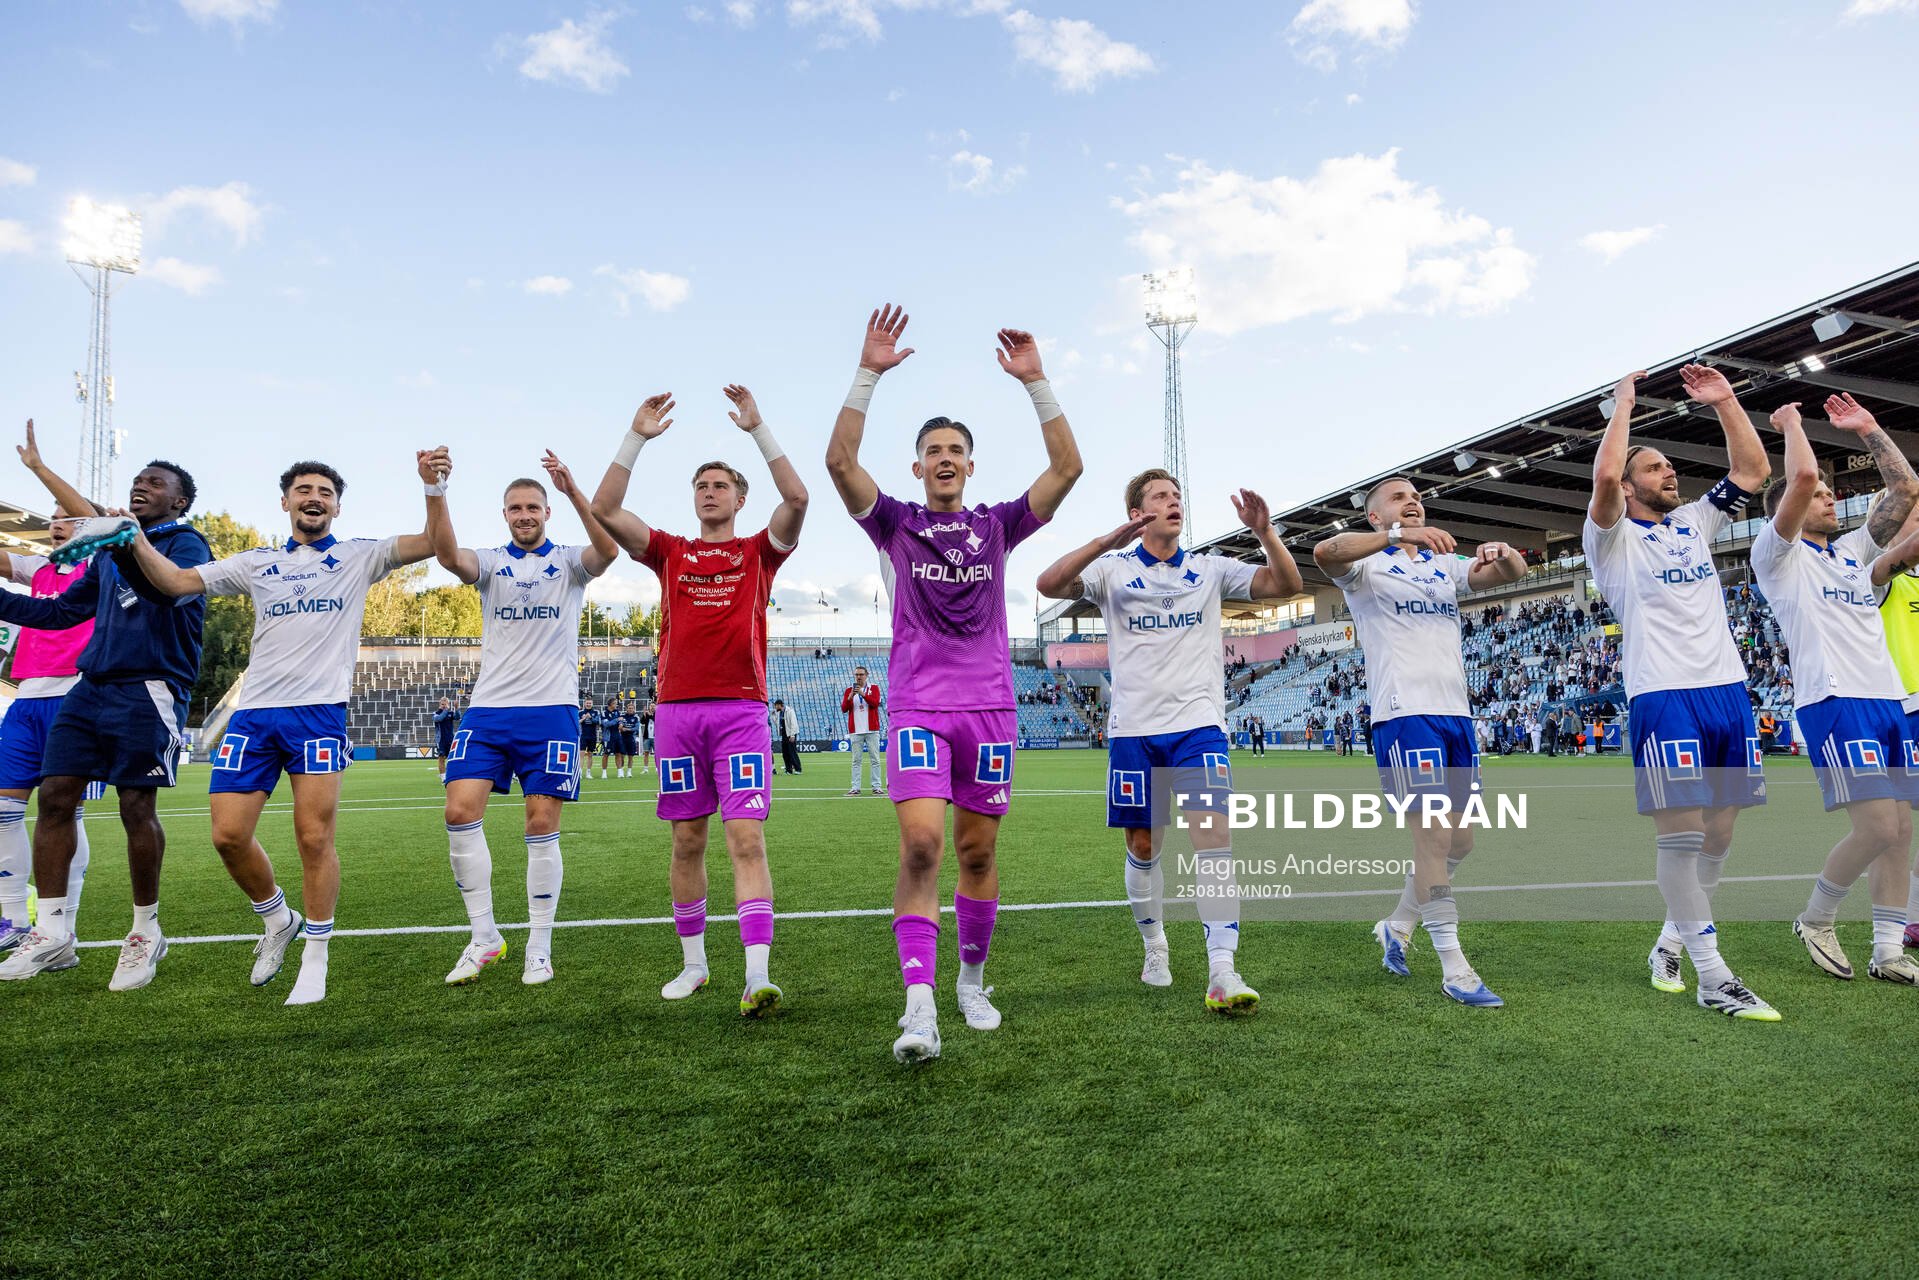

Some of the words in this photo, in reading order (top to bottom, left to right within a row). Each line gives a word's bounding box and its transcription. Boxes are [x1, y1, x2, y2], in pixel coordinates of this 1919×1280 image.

[281, 572, 318, 582] stadium
[911, 562, 992, 583] HOLMEN
[262, 598, 343, 620] HOLMEN
[1128, 610, 1203, 630] HOLMEN
[1298, 633, 1321, 647] Svenska
[1322, 630, 1344, 646] kyrkan
